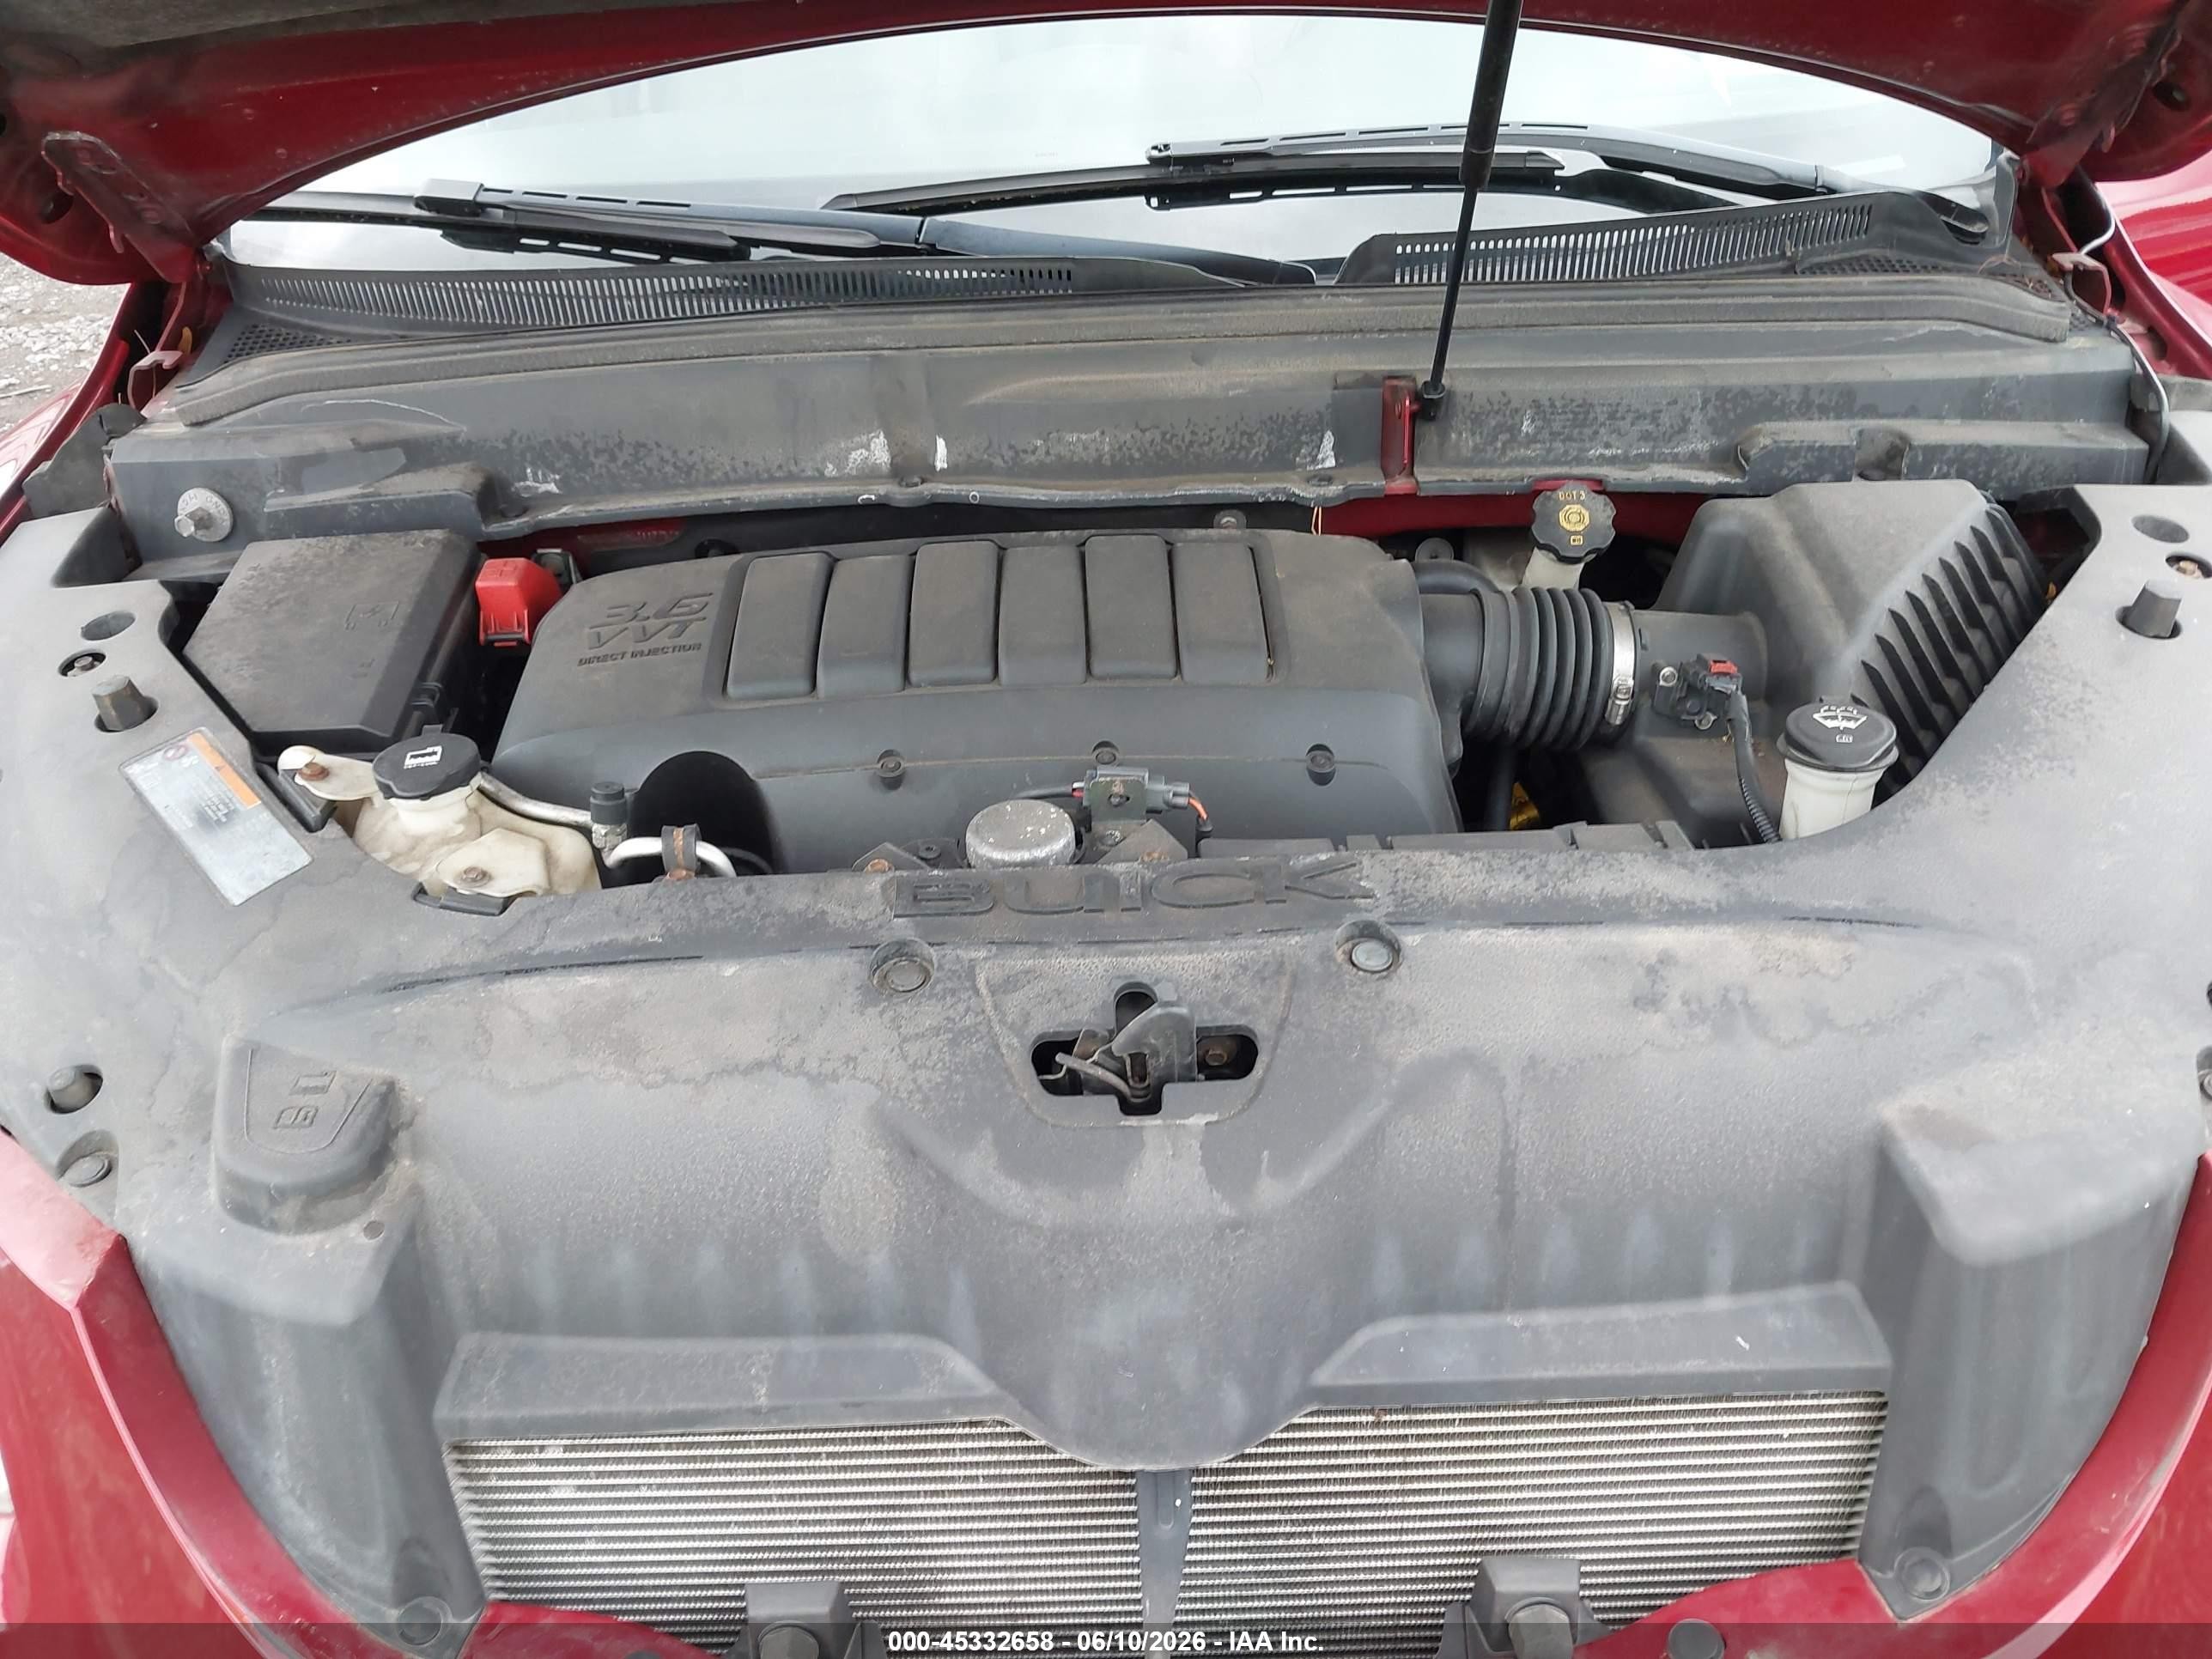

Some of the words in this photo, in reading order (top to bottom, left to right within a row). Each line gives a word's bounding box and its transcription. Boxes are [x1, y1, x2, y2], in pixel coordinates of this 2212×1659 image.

[1559, 490, 1577, 501] DOT
[1580, 489, 1586, 501] 3
[605, 592, 714, 623] 3.6
[587, 617, 707, 650] VVT
[577, 651, 628, 667] DIRECT
[631, 642, 702, 659] INJECTION
[892, 862, 1376, 919] BUICK
